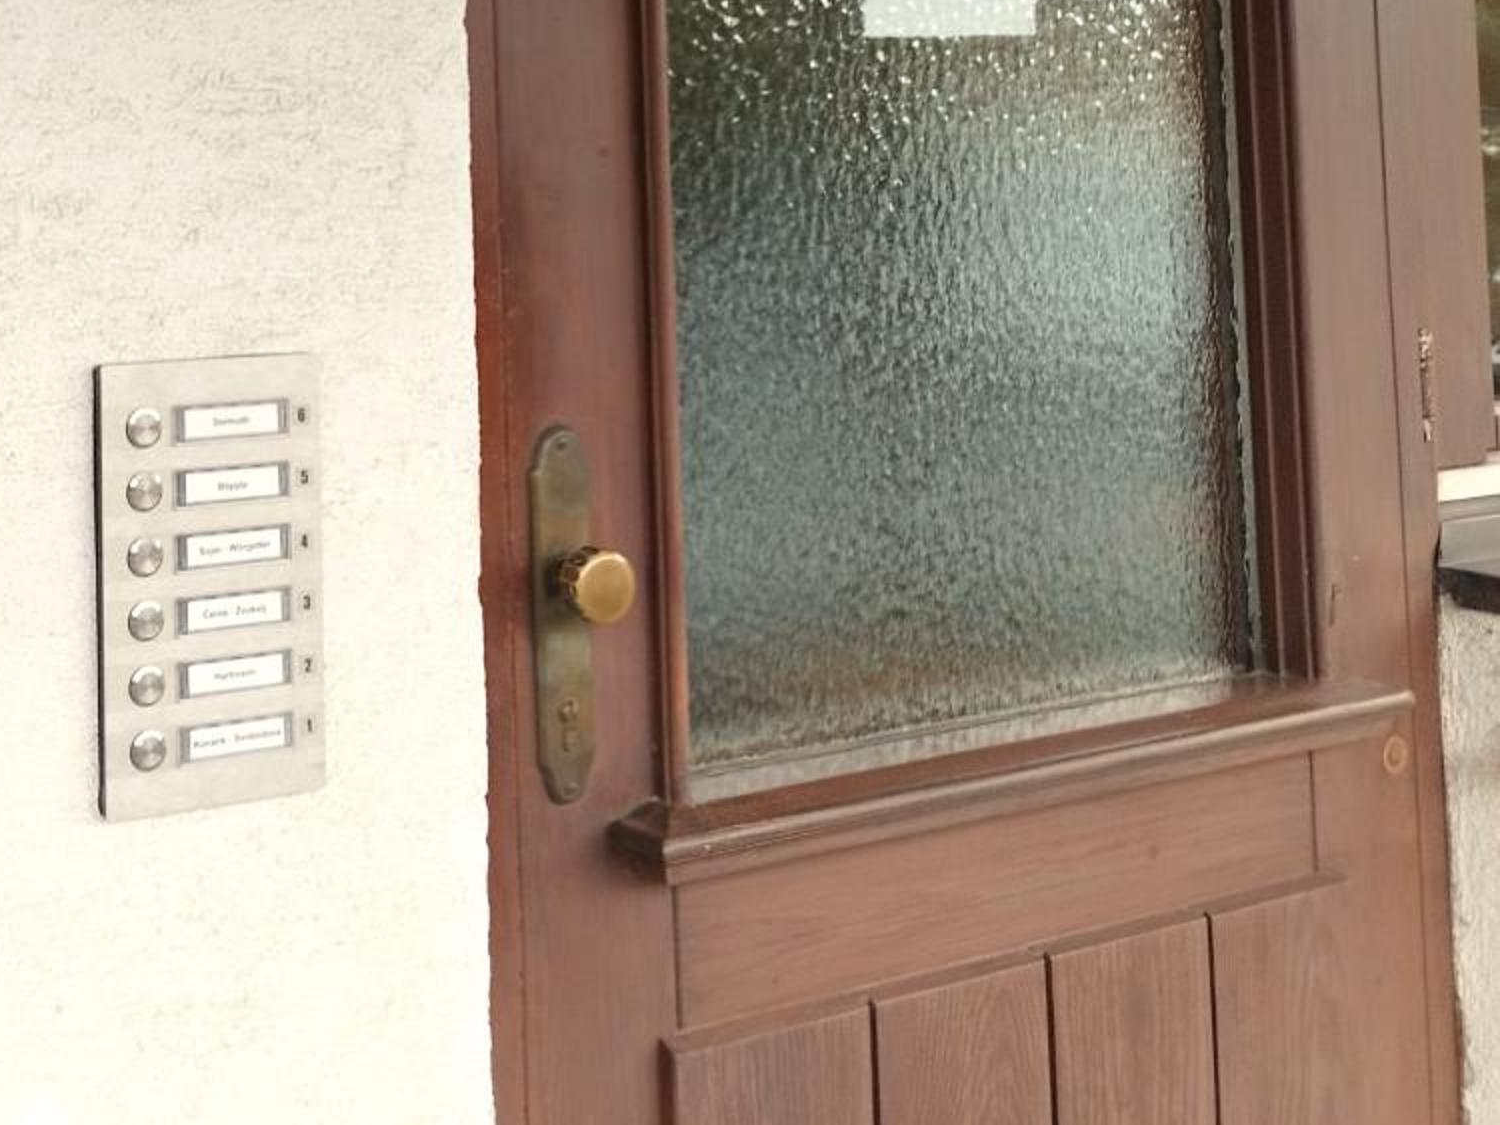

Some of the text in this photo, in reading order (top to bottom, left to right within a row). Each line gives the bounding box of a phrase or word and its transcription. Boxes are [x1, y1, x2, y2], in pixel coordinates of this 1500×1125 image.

[297, 407, 306, 423] 6
[300, 470, 309, 485] 5
[300, 533, 309, 548] 4
[303, 594, 311, 610] 3
[304, 657, 312, 673] 2
